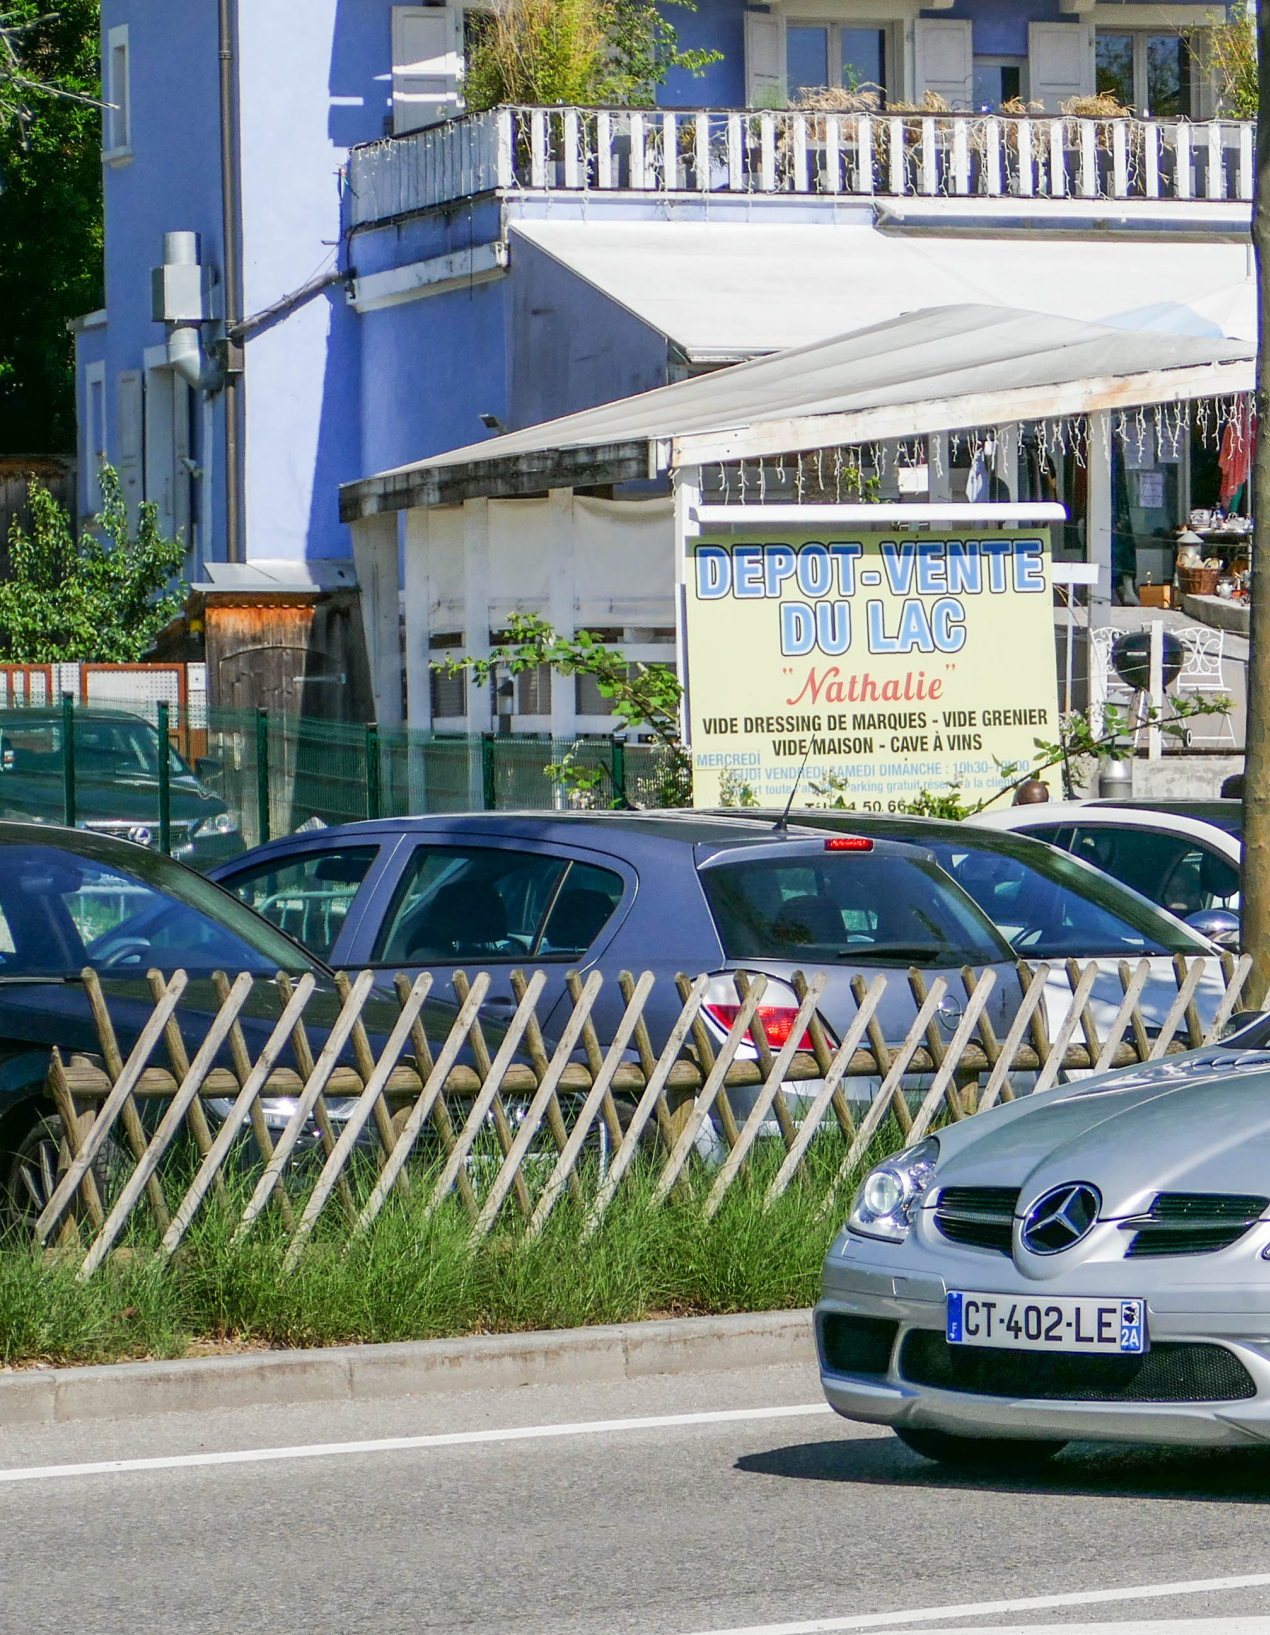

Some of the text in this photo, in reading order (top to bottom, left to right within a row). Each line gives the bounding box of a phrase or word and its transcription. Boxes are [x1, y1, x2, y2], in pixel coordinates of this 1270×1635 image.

[695, 538, 1045, 600] DEPOT-VENTE
[779, 597, 966, 656] DU LAC
[703, 718, 738, 734] VIDE
[744, 715, 821, 733] DRESSING
[828, 714, 847, 731] DE
[852, 712, 926, 731] MARQUES
[942, 711, 976, 727] VIDE
[982, 709, 1047, 726] GRENIER
[772, 739, 807, 756] VIDE
[813, 737, 873, 755] MAISON
[890, 735, 928, 753] CAVE
[933, 730, 943, 751] À
[947, 733, 982, 751] VINS
[697, 753, 760, 767] MERCREDI
[765, 766, 824, 780] VENDREDI
[880, 762, 942, 776] DIMANCHE
[952, 1322, 957, 1333] F
[965, 1300, 1139, 1347] CT-402-LE 2A
